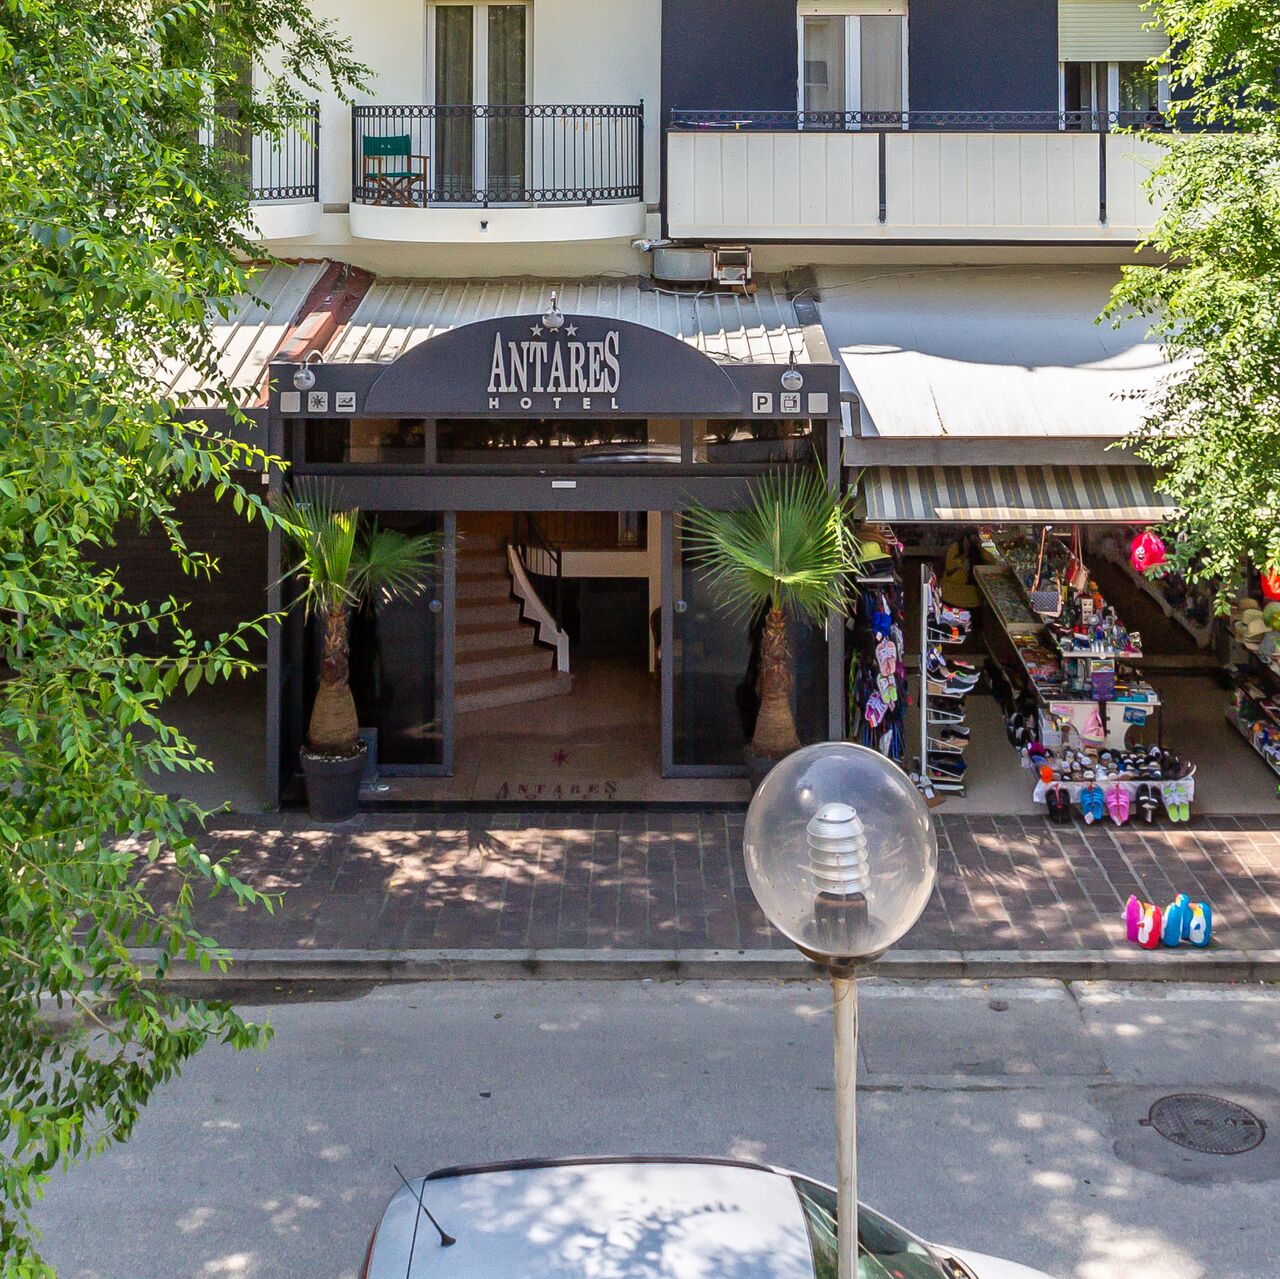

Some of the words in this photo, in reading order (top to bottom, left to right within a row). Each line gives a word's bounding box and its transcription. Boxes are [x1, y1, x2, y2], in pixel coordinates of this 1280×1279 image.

[487, 330, 620, 393] ANTARES
[488, 397, 619, 410] HOTEL
[757, 395, 769, 410] P
